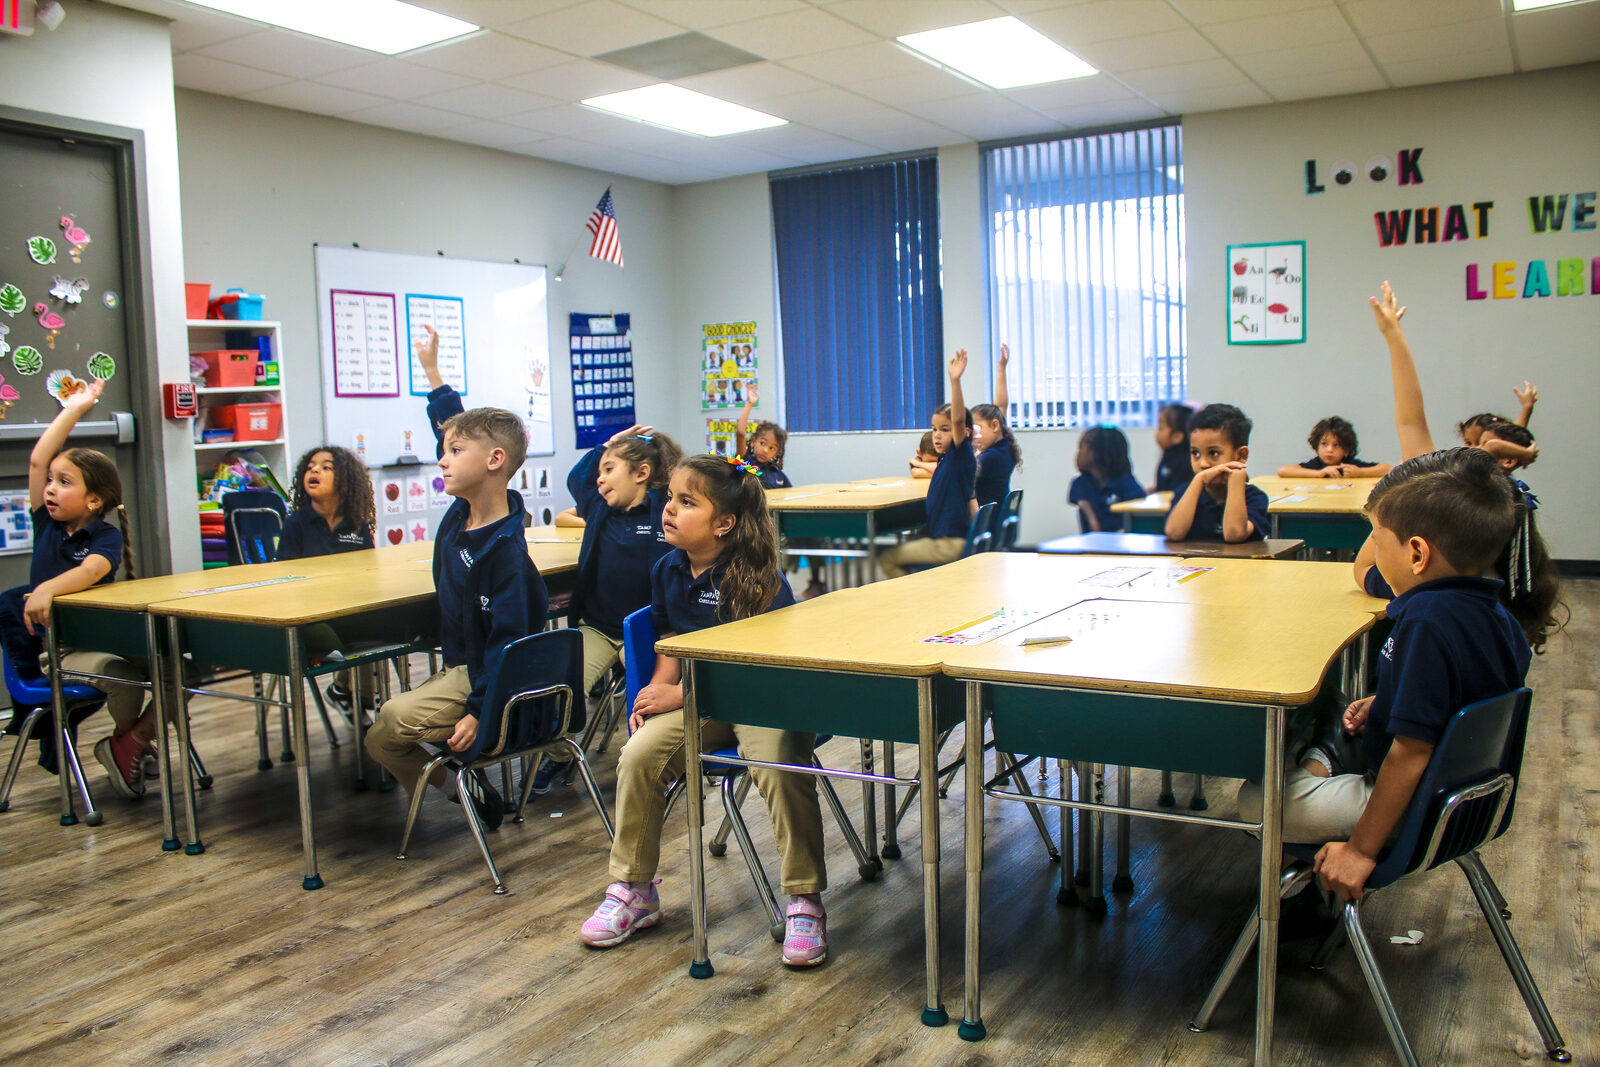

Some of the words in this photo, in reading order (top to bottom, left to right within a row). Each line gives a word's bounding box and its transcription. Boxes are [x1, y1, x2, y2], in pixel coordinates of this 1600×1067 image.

[1374, 201, 1494, 248] WHAT
[1527, 192, 1598, 235] WE
[1249, 265, 1264, 275] Aa
[1285, 274, 1302, 284] Oo
[1284, 314, 1300, 323] Uu
[176, 384, 194, 392] FIRE
[700, 591, 716, 599] TAMPA
